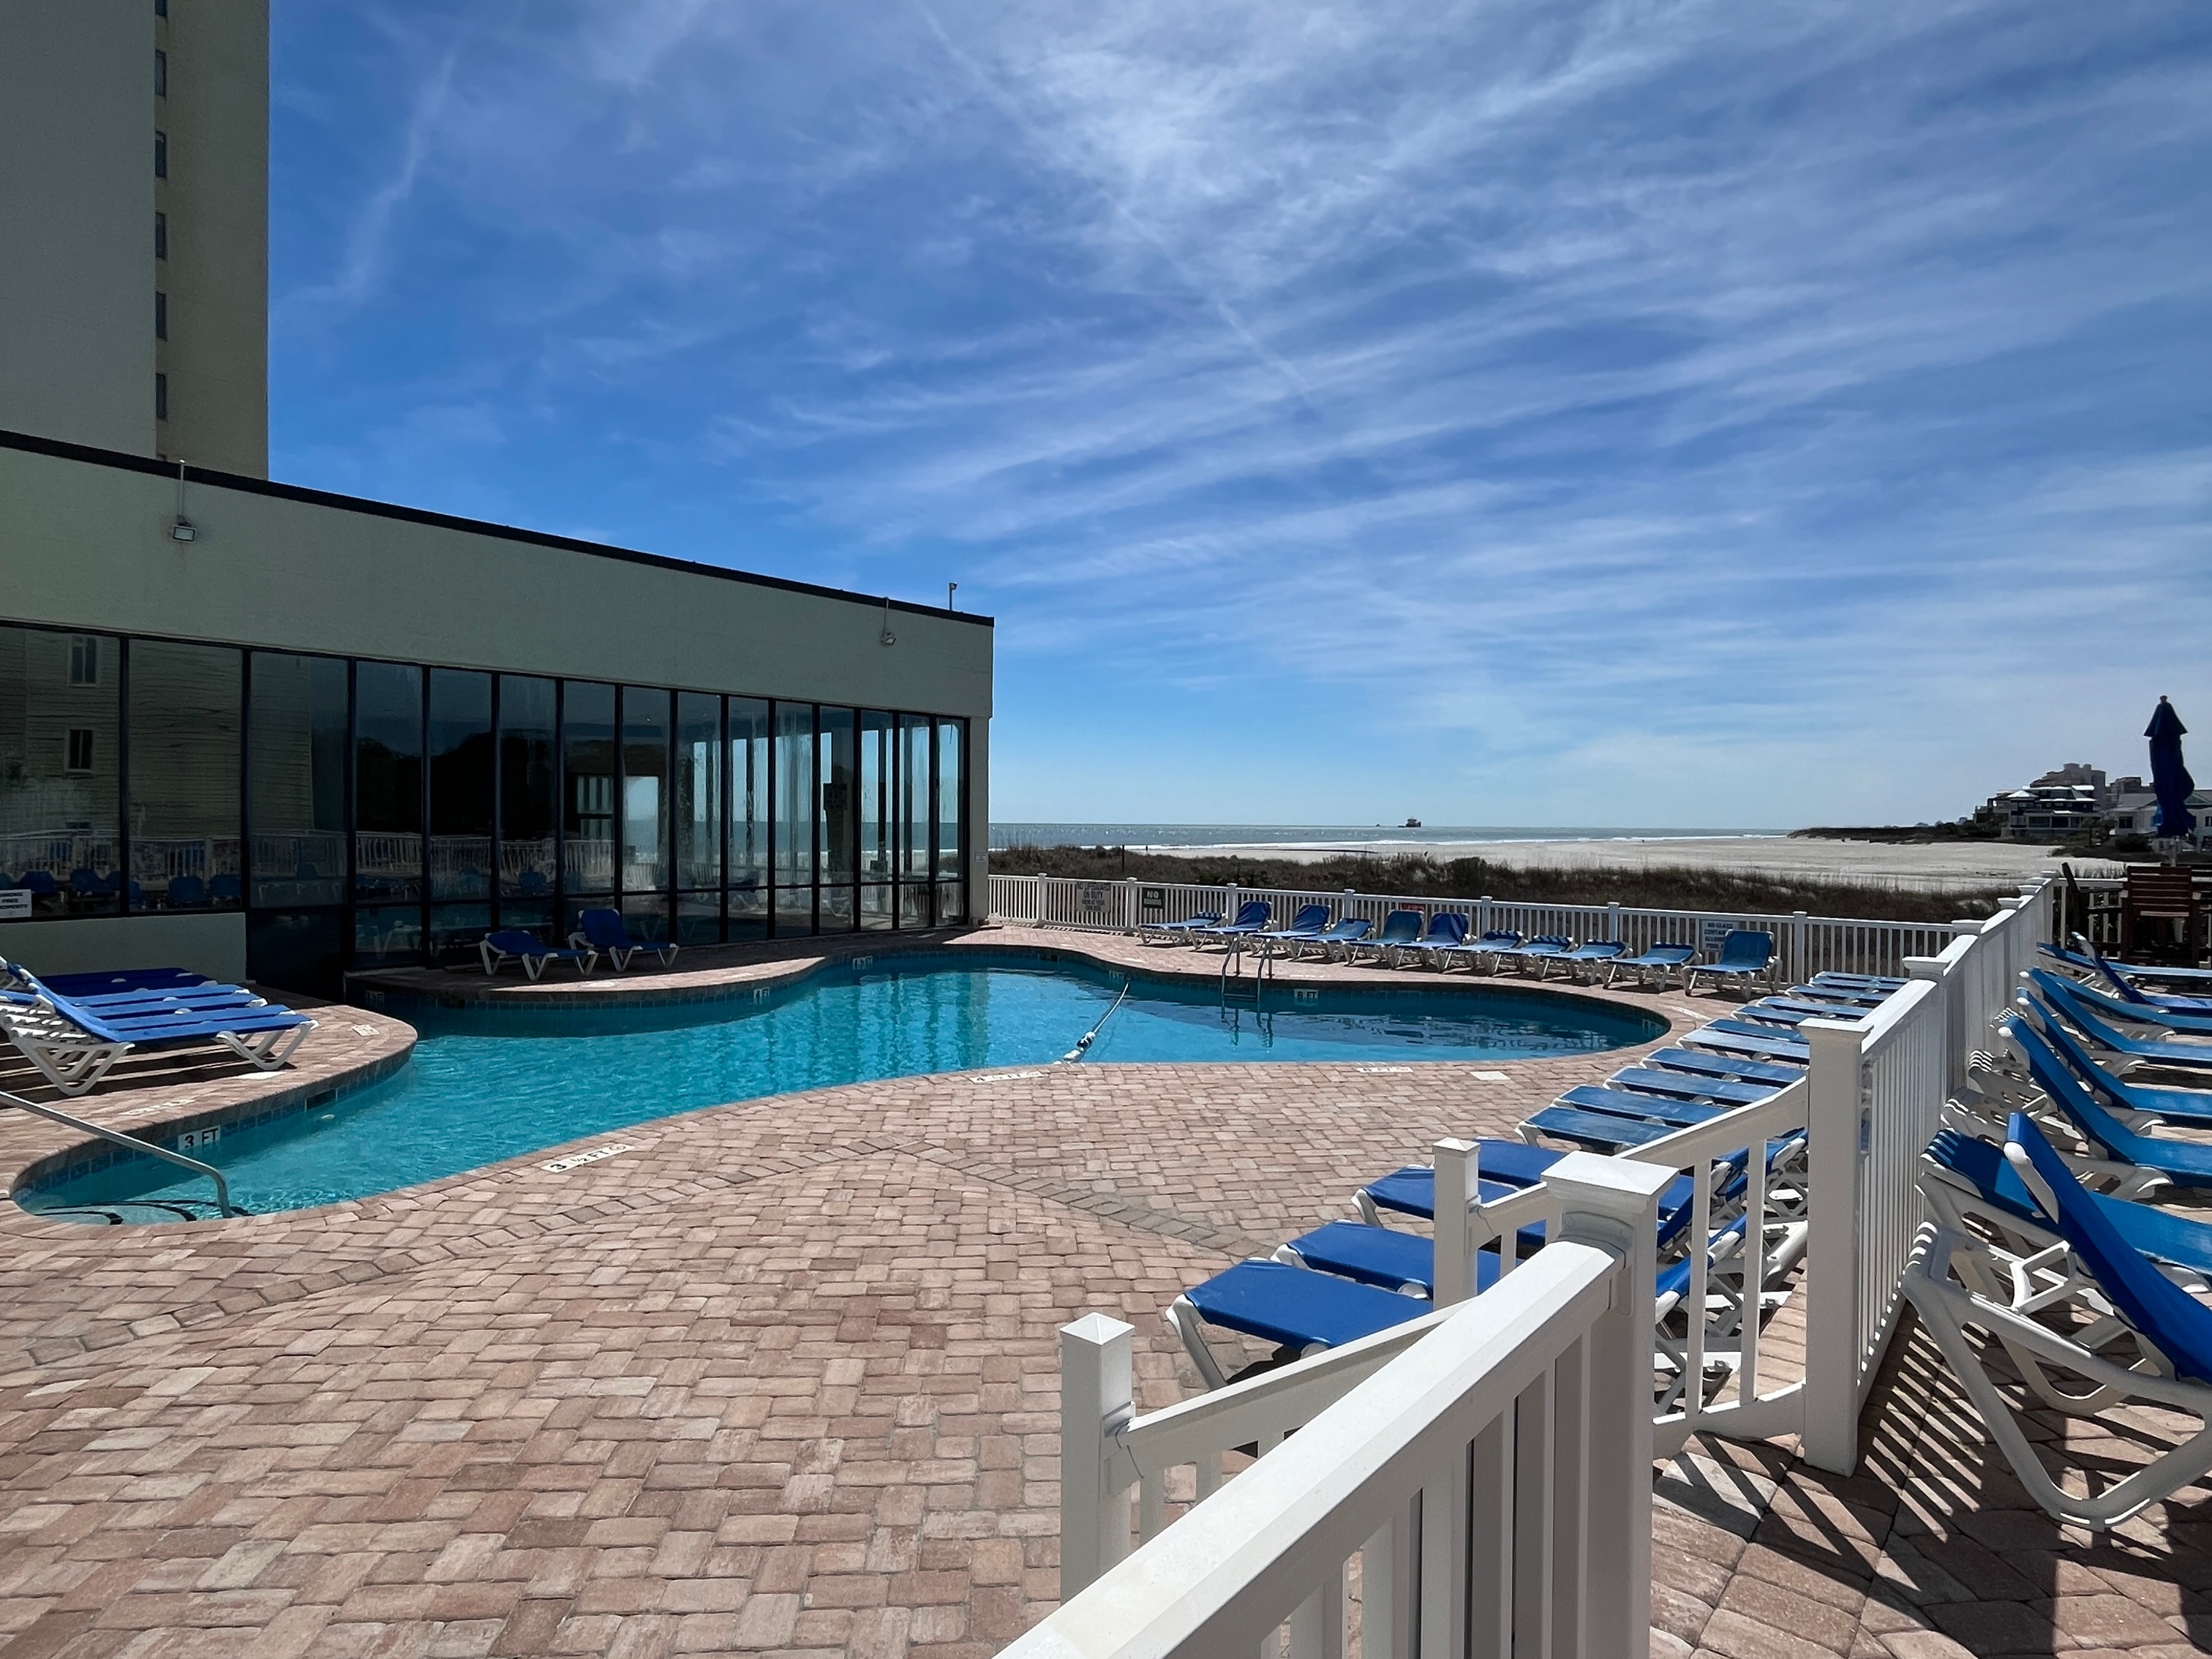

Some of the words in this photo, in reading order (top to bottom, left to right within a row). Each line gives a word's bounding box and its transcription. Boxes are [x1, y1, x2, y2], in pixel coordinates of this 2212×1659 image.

[184, 1135, 194, 1148] 3
[202, 1128, 218, 1144] FT
[587, 1150, 609, 1158] FT
